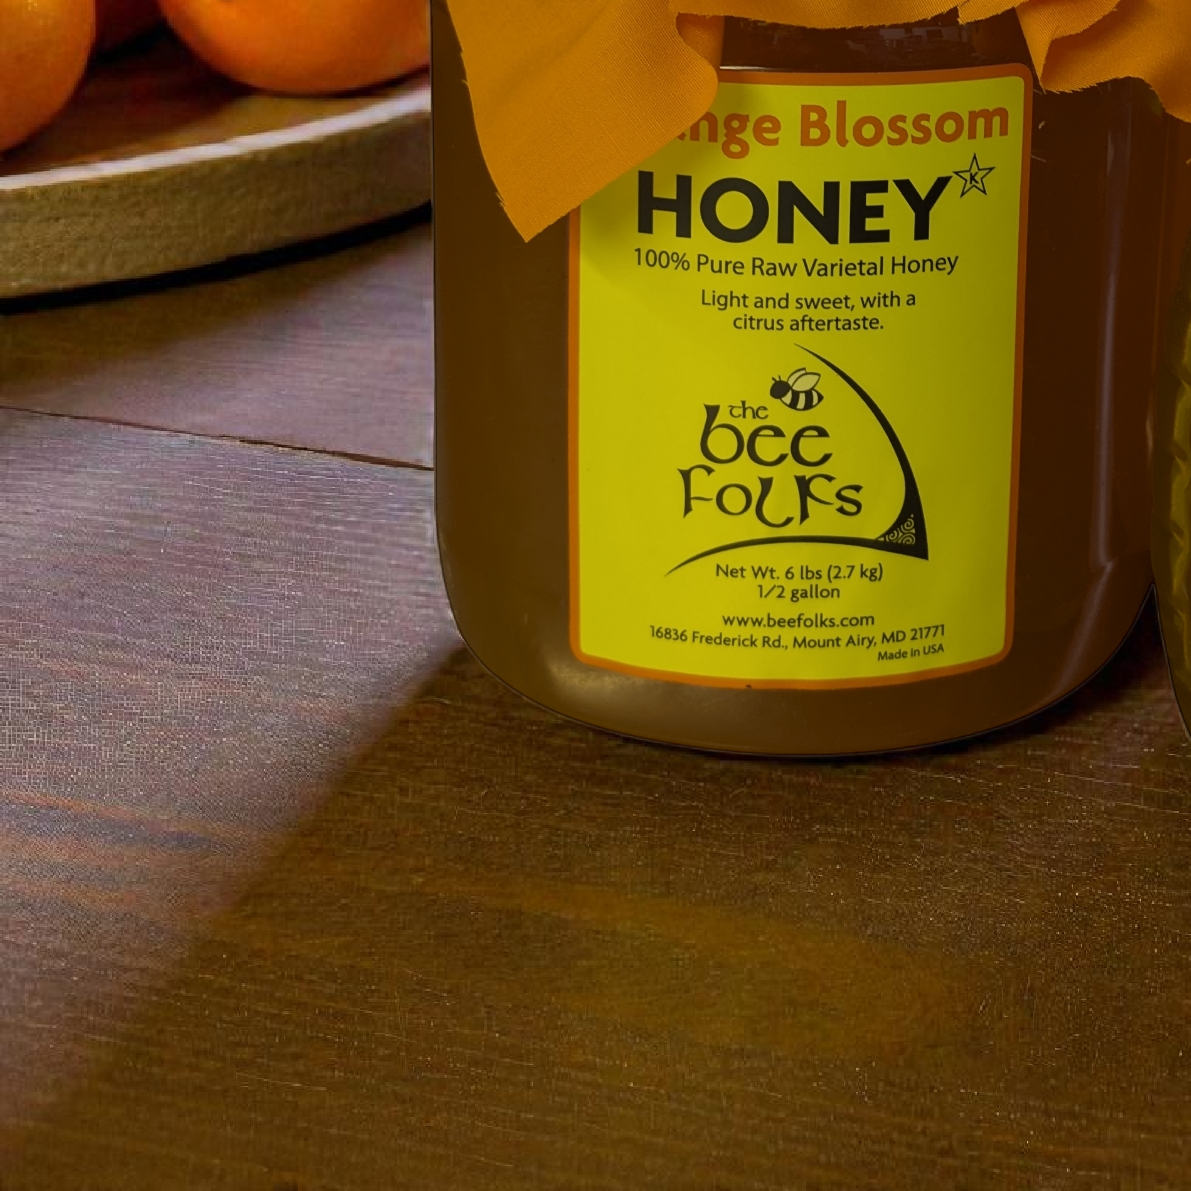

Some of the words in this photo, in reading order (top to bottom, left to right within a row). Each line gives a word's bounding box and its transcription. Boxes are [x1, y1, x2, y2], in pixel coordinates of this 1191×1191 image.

[678, 111, 781, 159] nge
[800, 100, 1009, 149] Blossom
[969, 172, 978, 184] K
[637, 169, 953, 245] HONEY
[634, 247, 690, 272] 100%
[697, 254, 745, 277] Pure
[752, 257, 797, 277] Raw
[802, 257, 884, 277] Varietal
[891, 254, 958, 277] Honey
[701, 290, 750, 311] Light
[754, 290, 789, 310] and
[795, 293, 855, 312] sweet,
[861, 290, 900, 309] with
[905, 294, 916, 307] a
[733, 314, 785, 331] citrus
[789, 314, 885, 332] aftertaste.
[728, 400, 769, 420] the
[699, 403, 833, 467] bee
[677, 464, 863, 528] folks
[715, 563, 746, 579] Net
[751, 564, 780, 580] Wt.
[785, 566, 795, 580] 6
[800, 564, 822, 580] lbs
[827, 564, 856, 582] (2.7
[859, 563, 883, 582] kg)
[757, 584, 786, 599] 1/2
[790, 584, 840, 602] gallon
[722, 613, 875, 629] www.beefolks.com
[650, 625, 688, 643] 16836
[692, 631, 758, 648] Frederick
[762, 635, 788, 651] Rd.,
[793, 635, 842, 649] Mount
[846, 632, 877, 648] Airy,
[881, 629, 906, 644] MD
[910, 624, 945, 641] 21771
[877, 648, 907, 661] Made
[911, 646, 920, 657] in
[923, 643, 945, 656] USA
